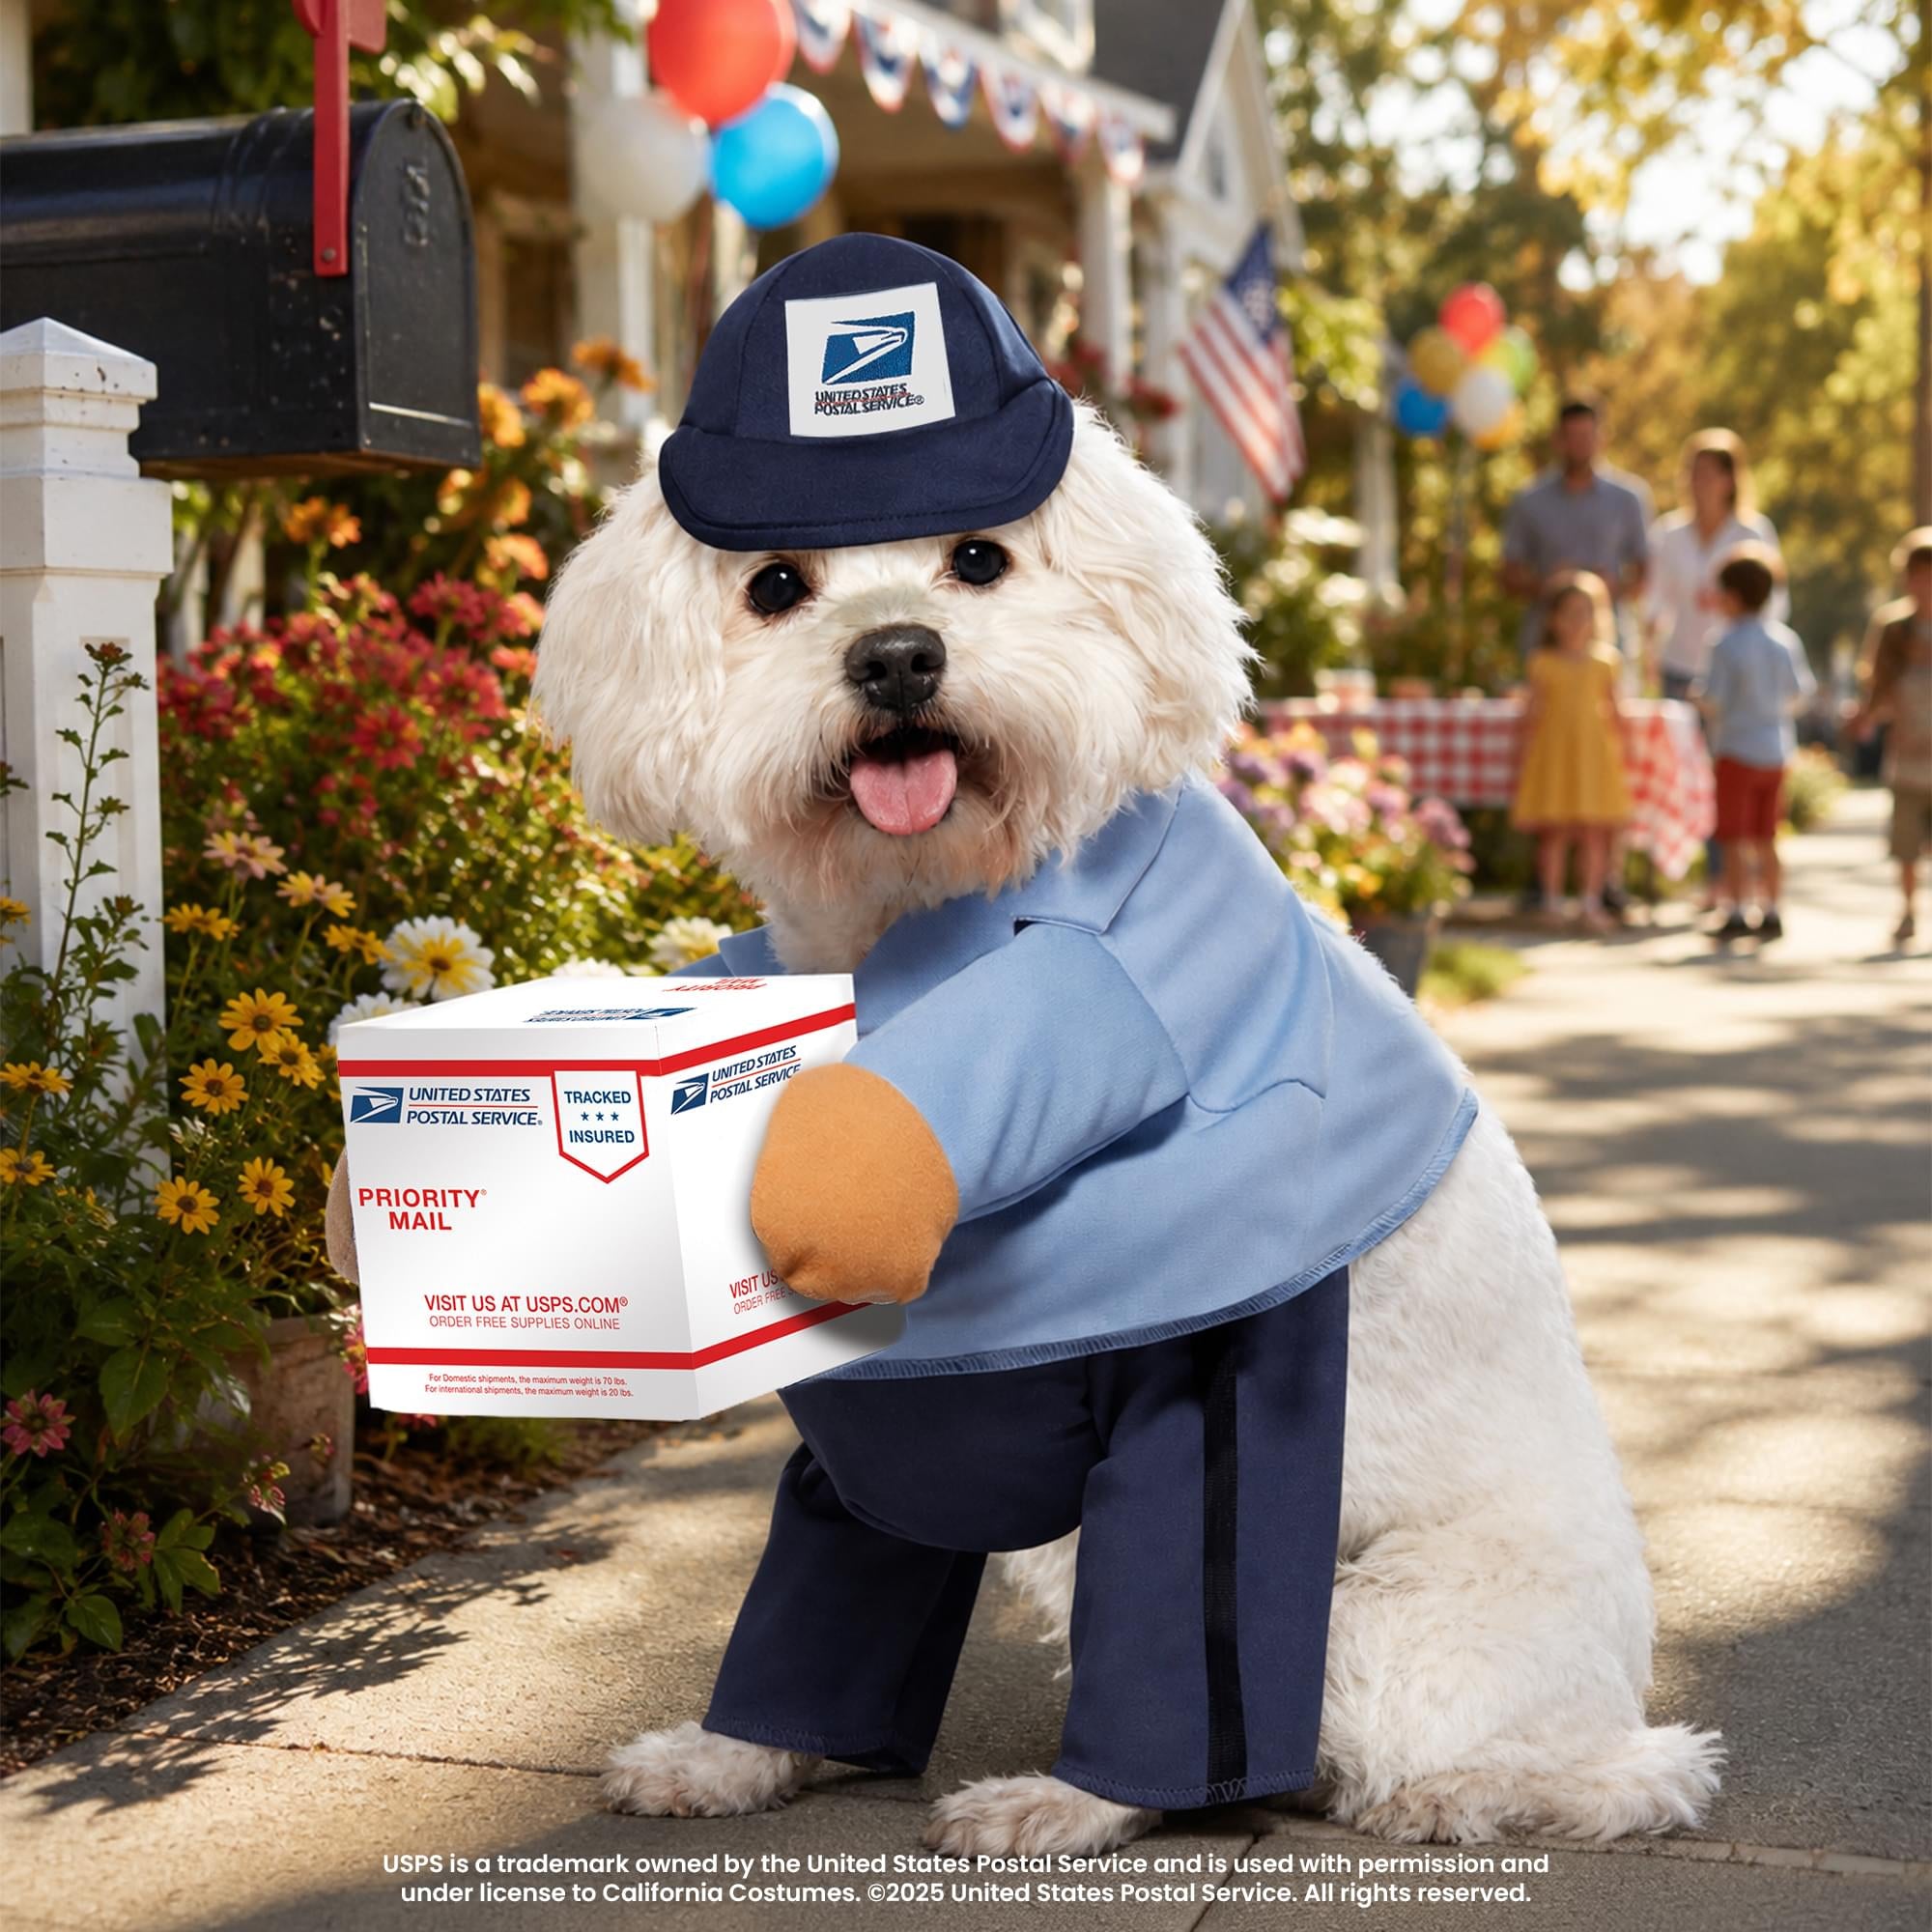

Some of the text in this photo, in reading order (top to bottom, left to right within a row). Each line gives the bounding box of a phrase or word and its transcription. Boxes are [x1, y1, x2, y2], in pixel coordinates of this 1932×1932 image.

[814, 383, 908, 403] UNITED STATES
[814, 402, 862, 416] POSTAL
[712, 1045, 797, 1083] UNITED STATES
[409, 1088, 531, 1103] UNITED STATES
[564, 1091, 632, 1104] TRACKED
[710, 1079, 753, 1104] POSTAL
[407, 1111, 469, 1125] POSTAL
[569, 1130, 636, 1144] INSURED
[388, 1211, 452, 1231] MAIL
[729, 1269, 779, 1299] VISIT US
[424, 1294, 468, 1312] VISIT
[471, 1295, 497, 1312] US
[501, 1295, 522, 1313] AT
[734, 1294, 763, 1314] ORDER
[765, 1287, 786, 1303] FREE
[429, 1315, 620, 1330] ORDER FREE SUPPLIES ONLINE
[429, 1373, 628, 1386] For Domestic shipments, the maximum weight is 70 lbs.
[424, 1384, 438, 1393] For
[439, 1385, 482, 1394] international
[483, 1386, 524, 1396] shipments,
[538, 1387, 574, 1396] maximum
[575, 1388, 600, 1398] weight
[601, 1388, 608, 1397] is
[609, 1388, 618, 1397] 20
